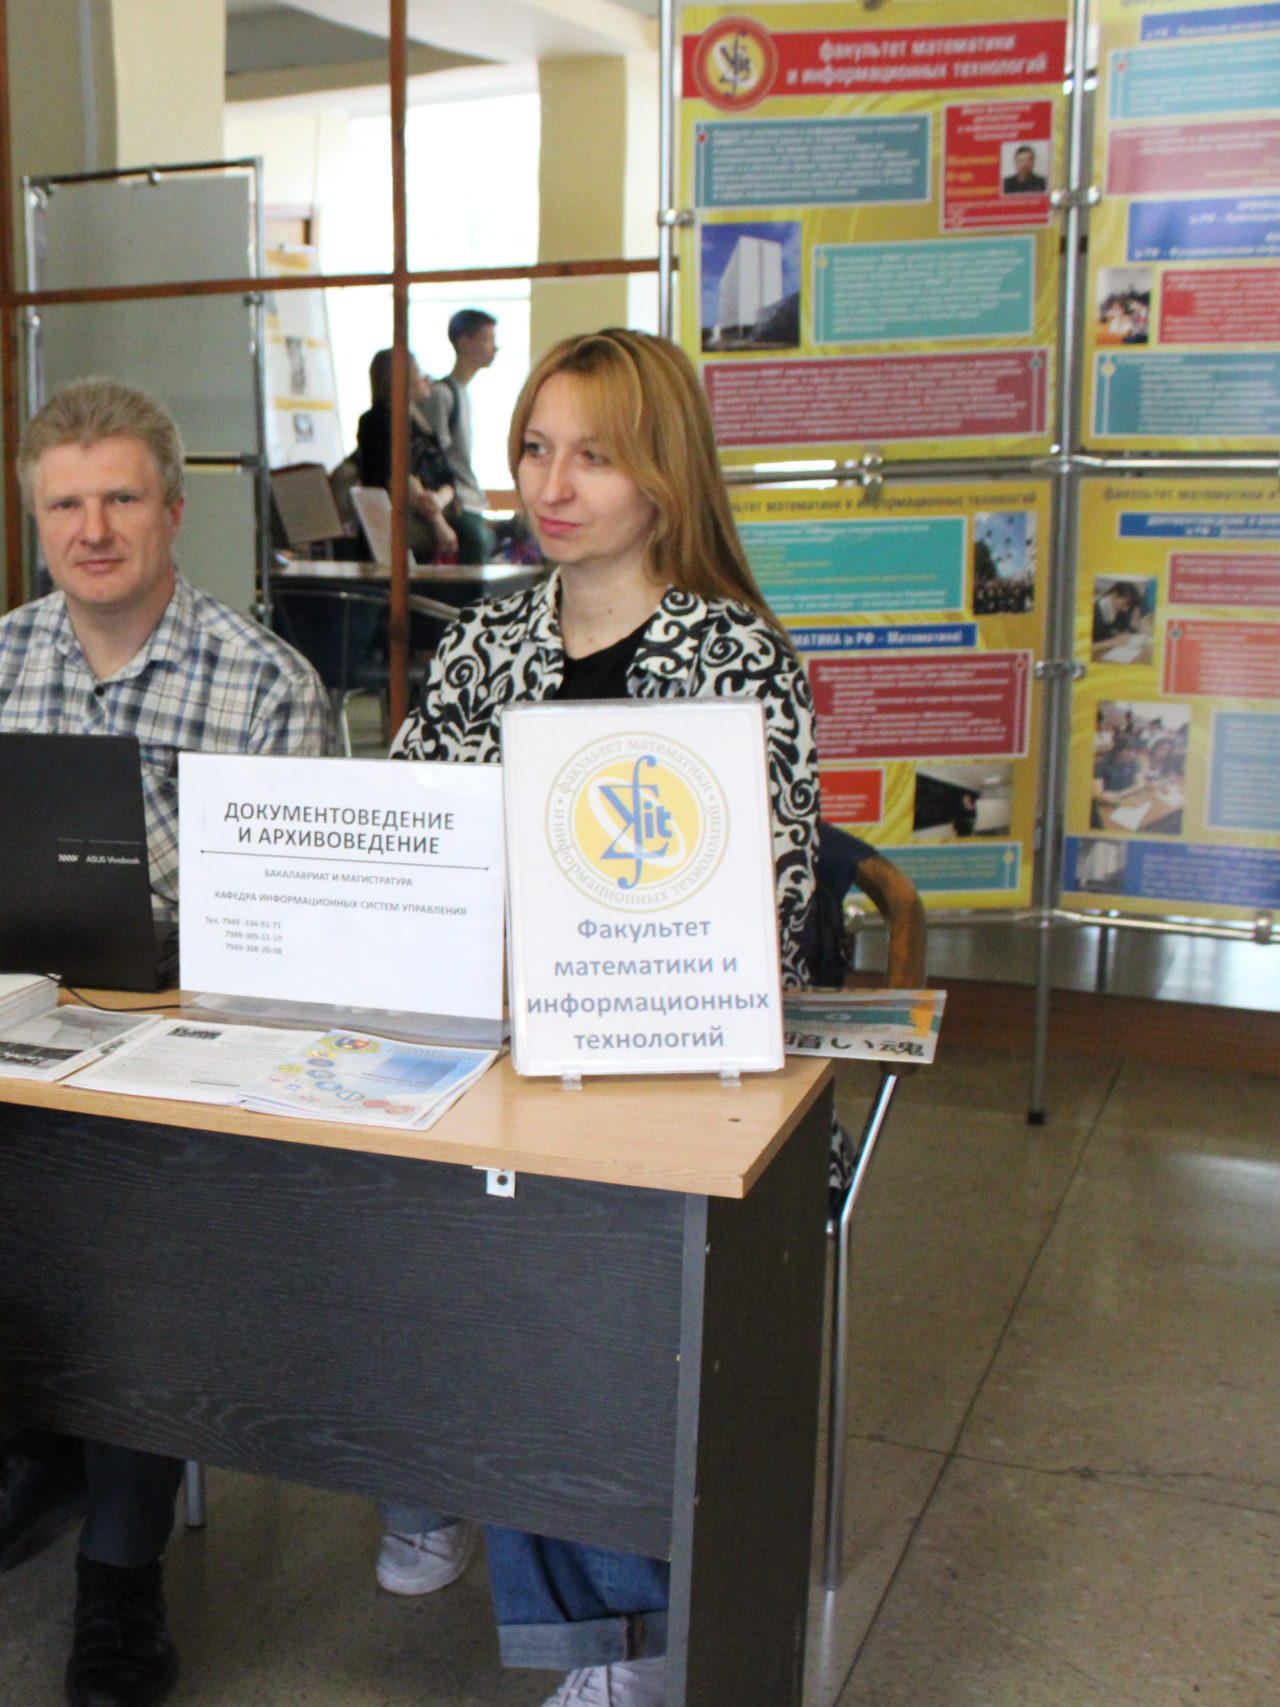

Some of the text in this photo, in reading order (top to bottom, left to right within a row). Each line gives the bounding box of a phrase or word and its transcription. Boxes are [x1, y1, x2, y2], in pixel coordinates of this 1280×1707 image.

[224, 802, 455, 831] ДОКУМЕНТОВЕДЕНИЕ
[238, 827, 440, 855] И АРХИВОВЕДЕНИЕ
[264, 869, 413, 887] БАКАЛАВРИАТ И МАГИСТРАТУРА
[214, 890, 468, 917] КАФЕДРА ИНФОРМАЦИОННЫХ СИСТЕМ УПРАВЛЕНИЯ
[577, 917, 712, 943] Факультет
[554, 956, 738, 977] математики и
[527, 991, 770, 1018] информационных
[573, 1025, 724, 1051] технологий
